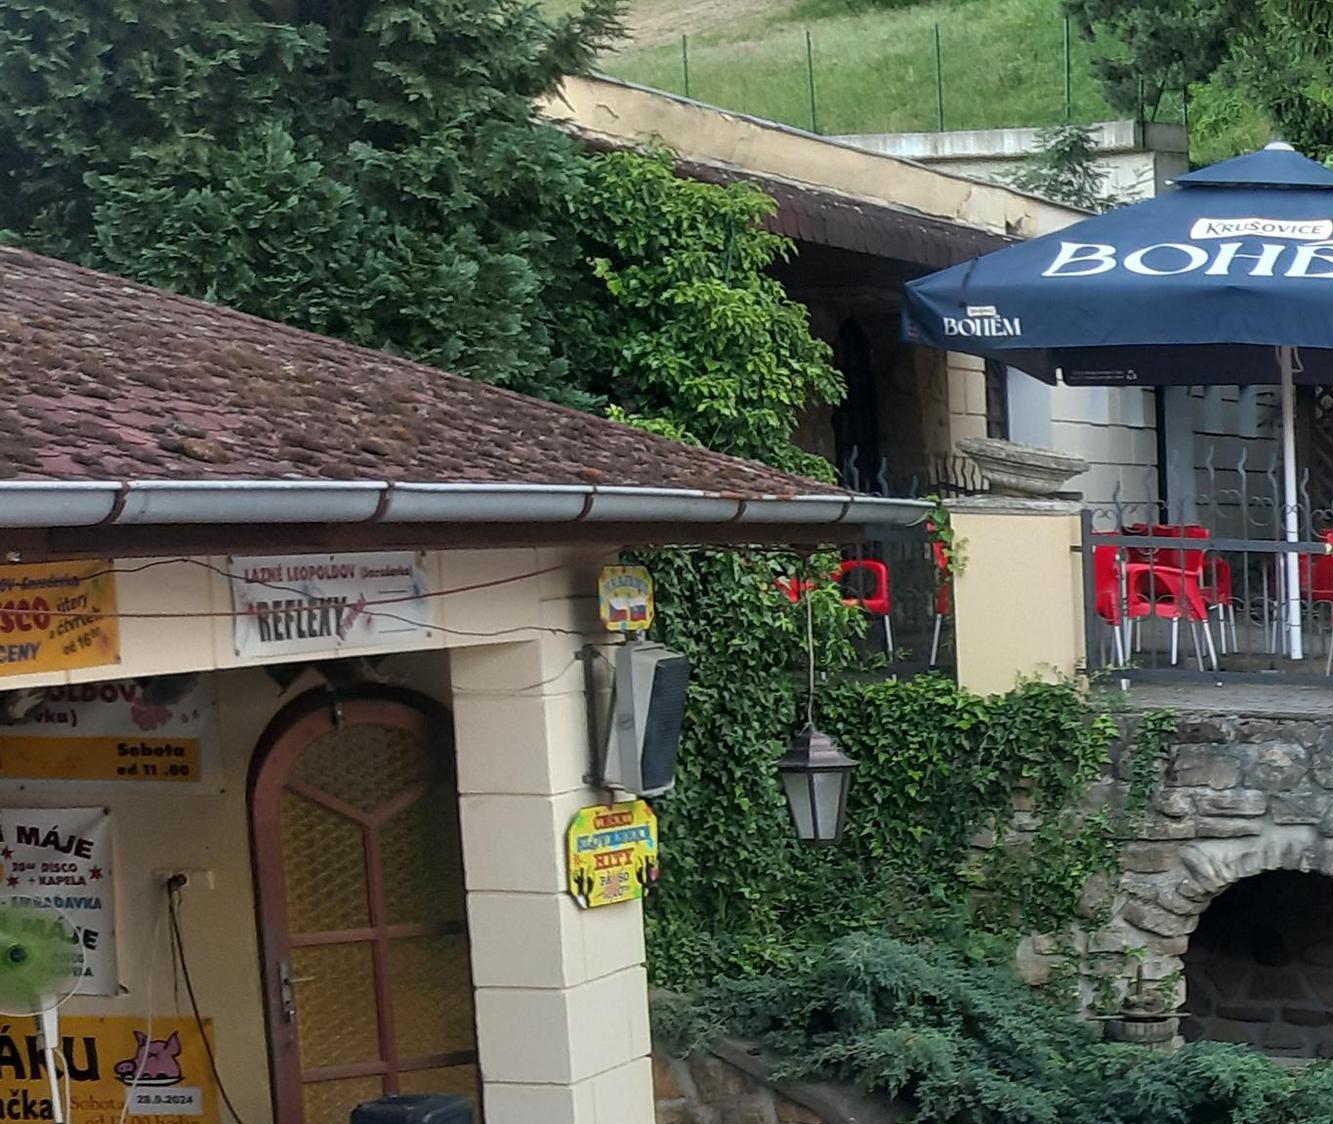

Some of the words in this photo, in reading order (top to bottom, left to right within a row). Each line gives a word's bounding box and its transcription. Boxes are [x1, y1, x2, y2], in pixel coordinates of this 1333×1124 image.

[1205, 219, 1323, 237] KRUŠOVICE
[943, 314, 1023, 337] BOHÉM
[16, 824, 94, 860] MÁJE
